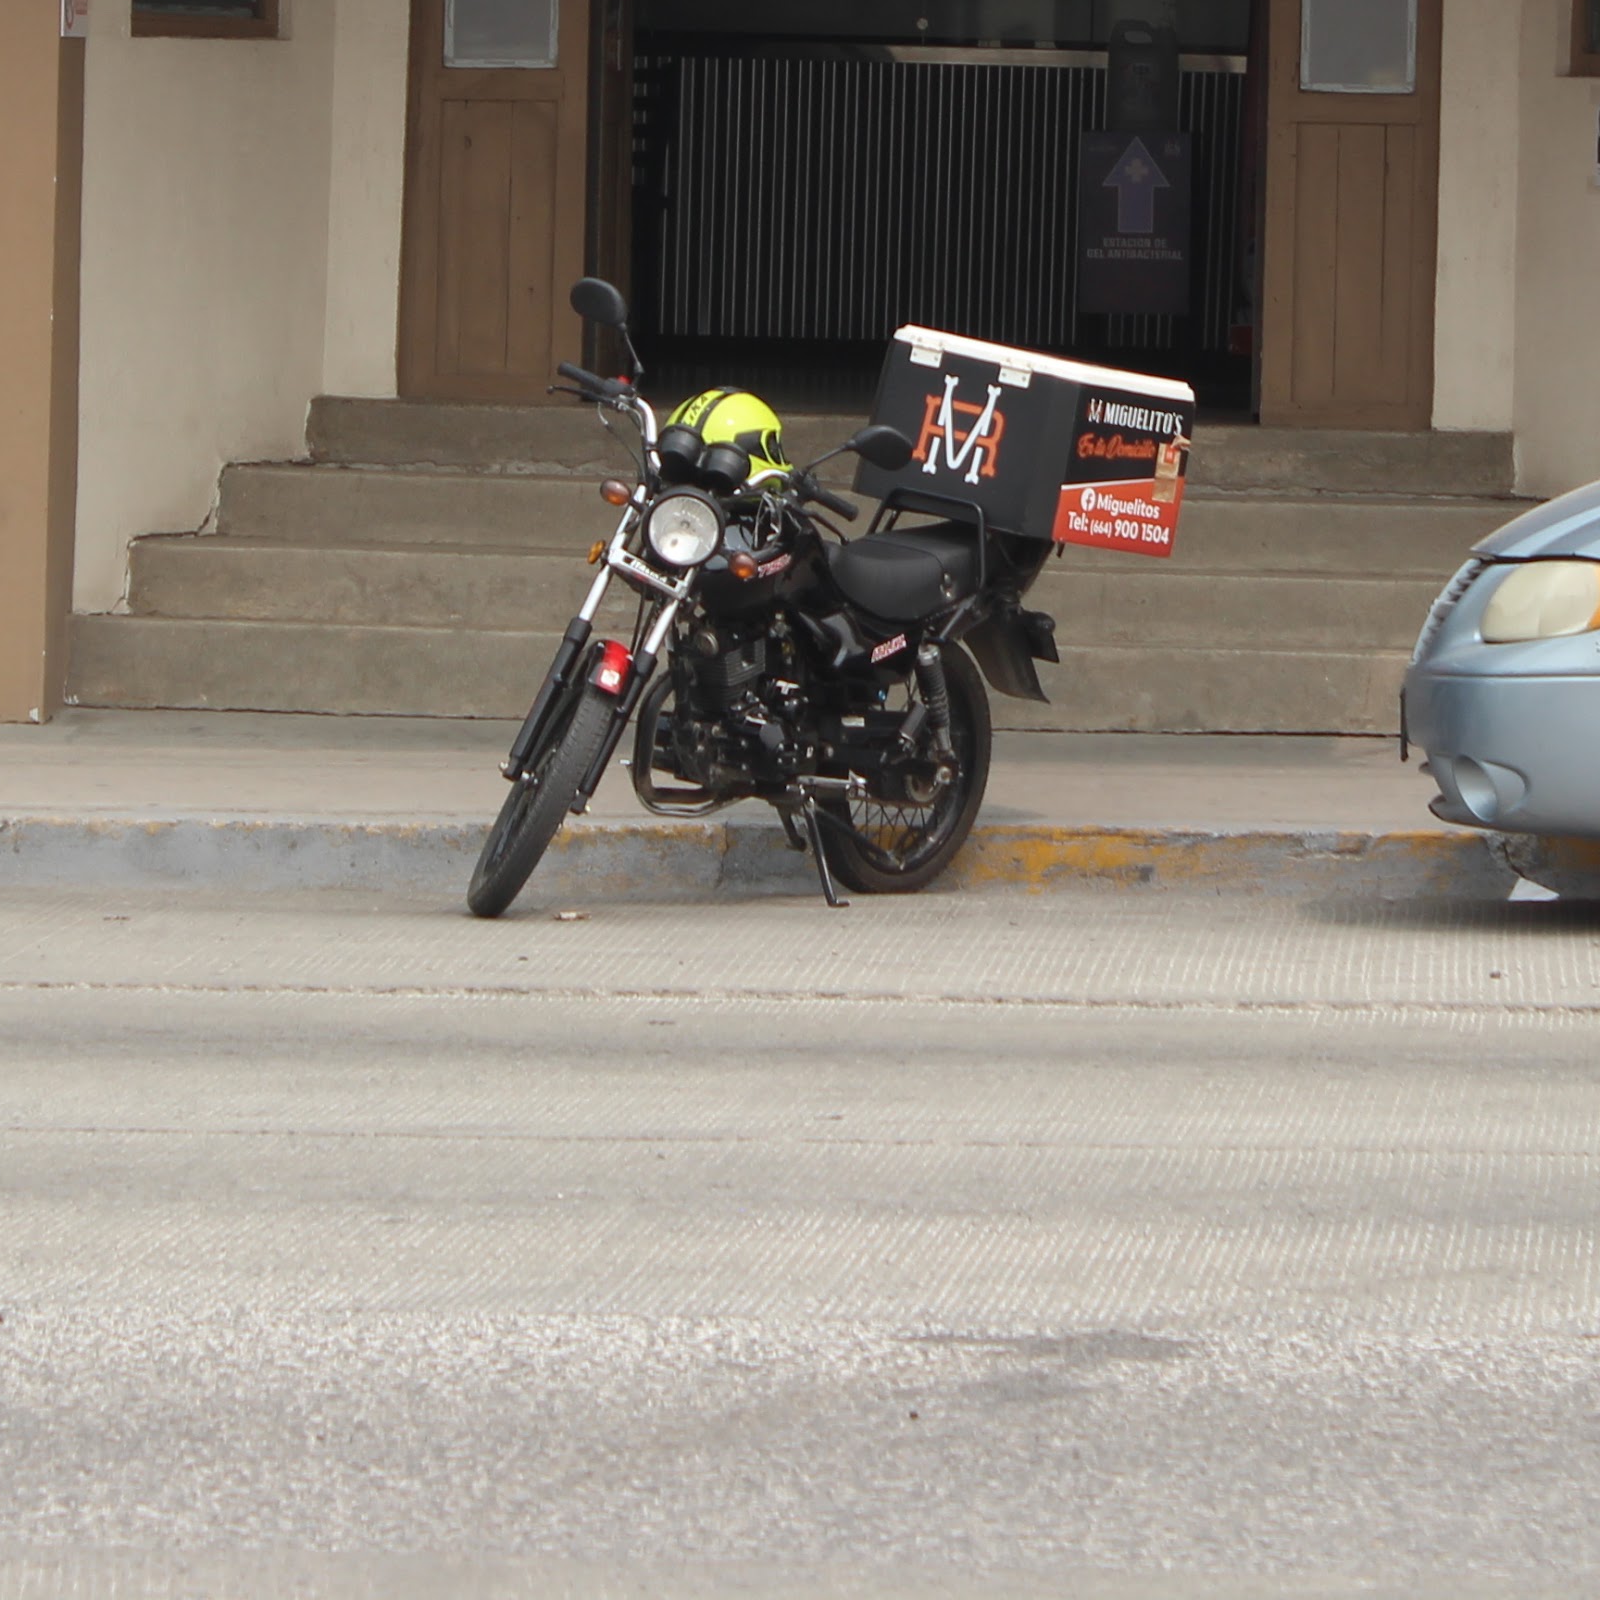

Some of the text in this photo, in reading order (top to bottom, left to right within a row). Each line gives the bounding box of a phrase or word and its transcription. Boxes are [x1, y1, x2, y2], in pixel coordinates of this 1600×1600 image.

[1096, 492, 1160, 520] Miguelitos
[1068, 511, 1170, 545] Tel: (664) 900 1504
